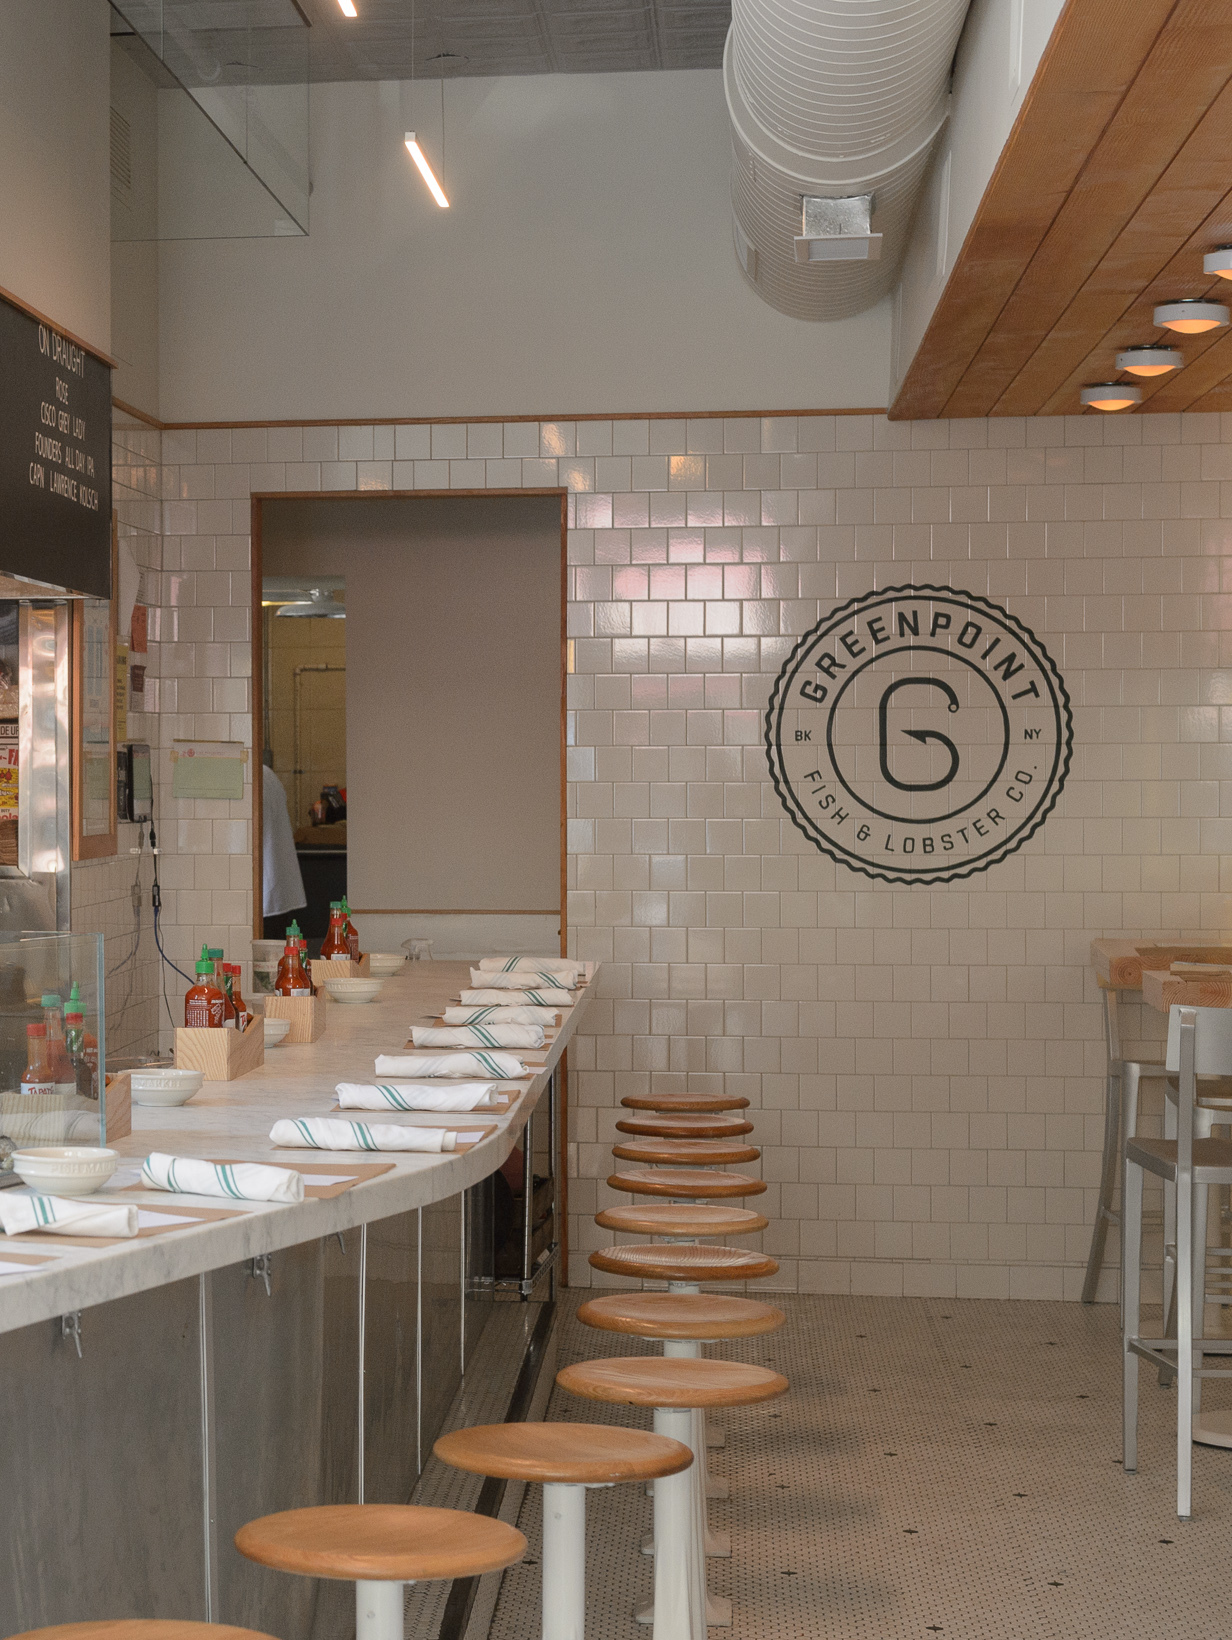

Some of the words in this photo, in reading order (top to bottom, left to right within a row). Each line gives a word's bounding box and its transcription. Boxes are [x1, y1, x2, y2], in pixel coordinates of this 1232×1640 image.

[38, 323, 50, 357] ON
[52, 333, 86, 379] DRAUGHT
[35, 431, 62, 464] FOUNDERS
[799, 610, 1040, 704] GREENPOINT
[794, 730, 812, 742] BK
[1024, 728, 1042, 740] NY
[803, 769, 850, 826] FISH
[856, 823, 871, 842] &
[884, 807, 1006, 854] LOBSTER
[1005, 764, 1038, 803] CO.
